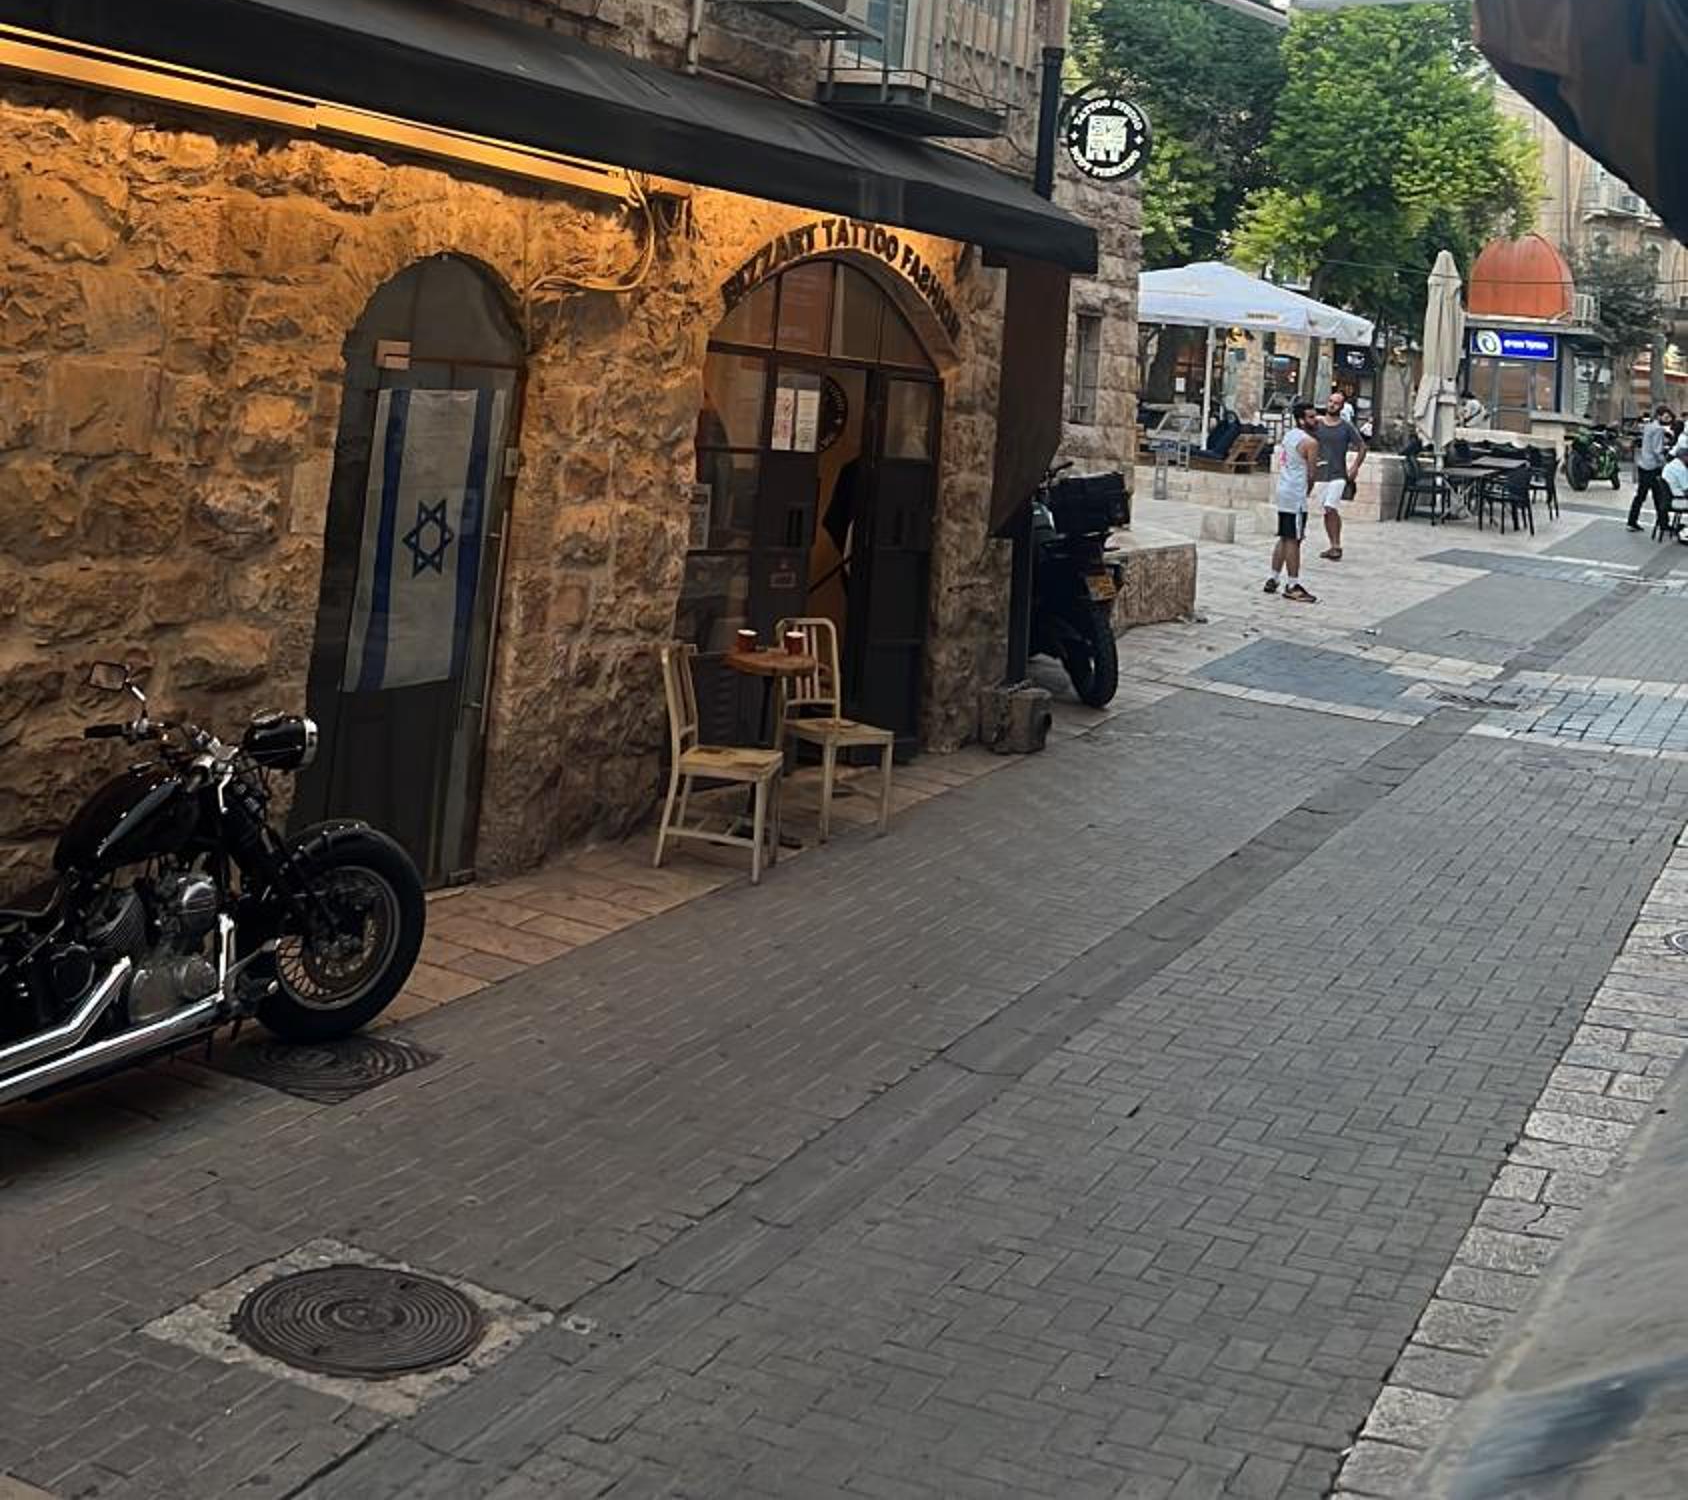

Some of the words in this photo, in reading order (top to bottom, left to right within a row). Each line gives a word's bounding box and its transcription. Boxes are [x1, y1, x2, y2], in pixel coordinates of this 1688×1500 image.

[1072, 99, 1111, 126] TATTOO
[1091, 149, 1142, 178] PIERCING
[821, 218, 899, 263] TATTOO
[900, 243, 962, 344] FASHION
